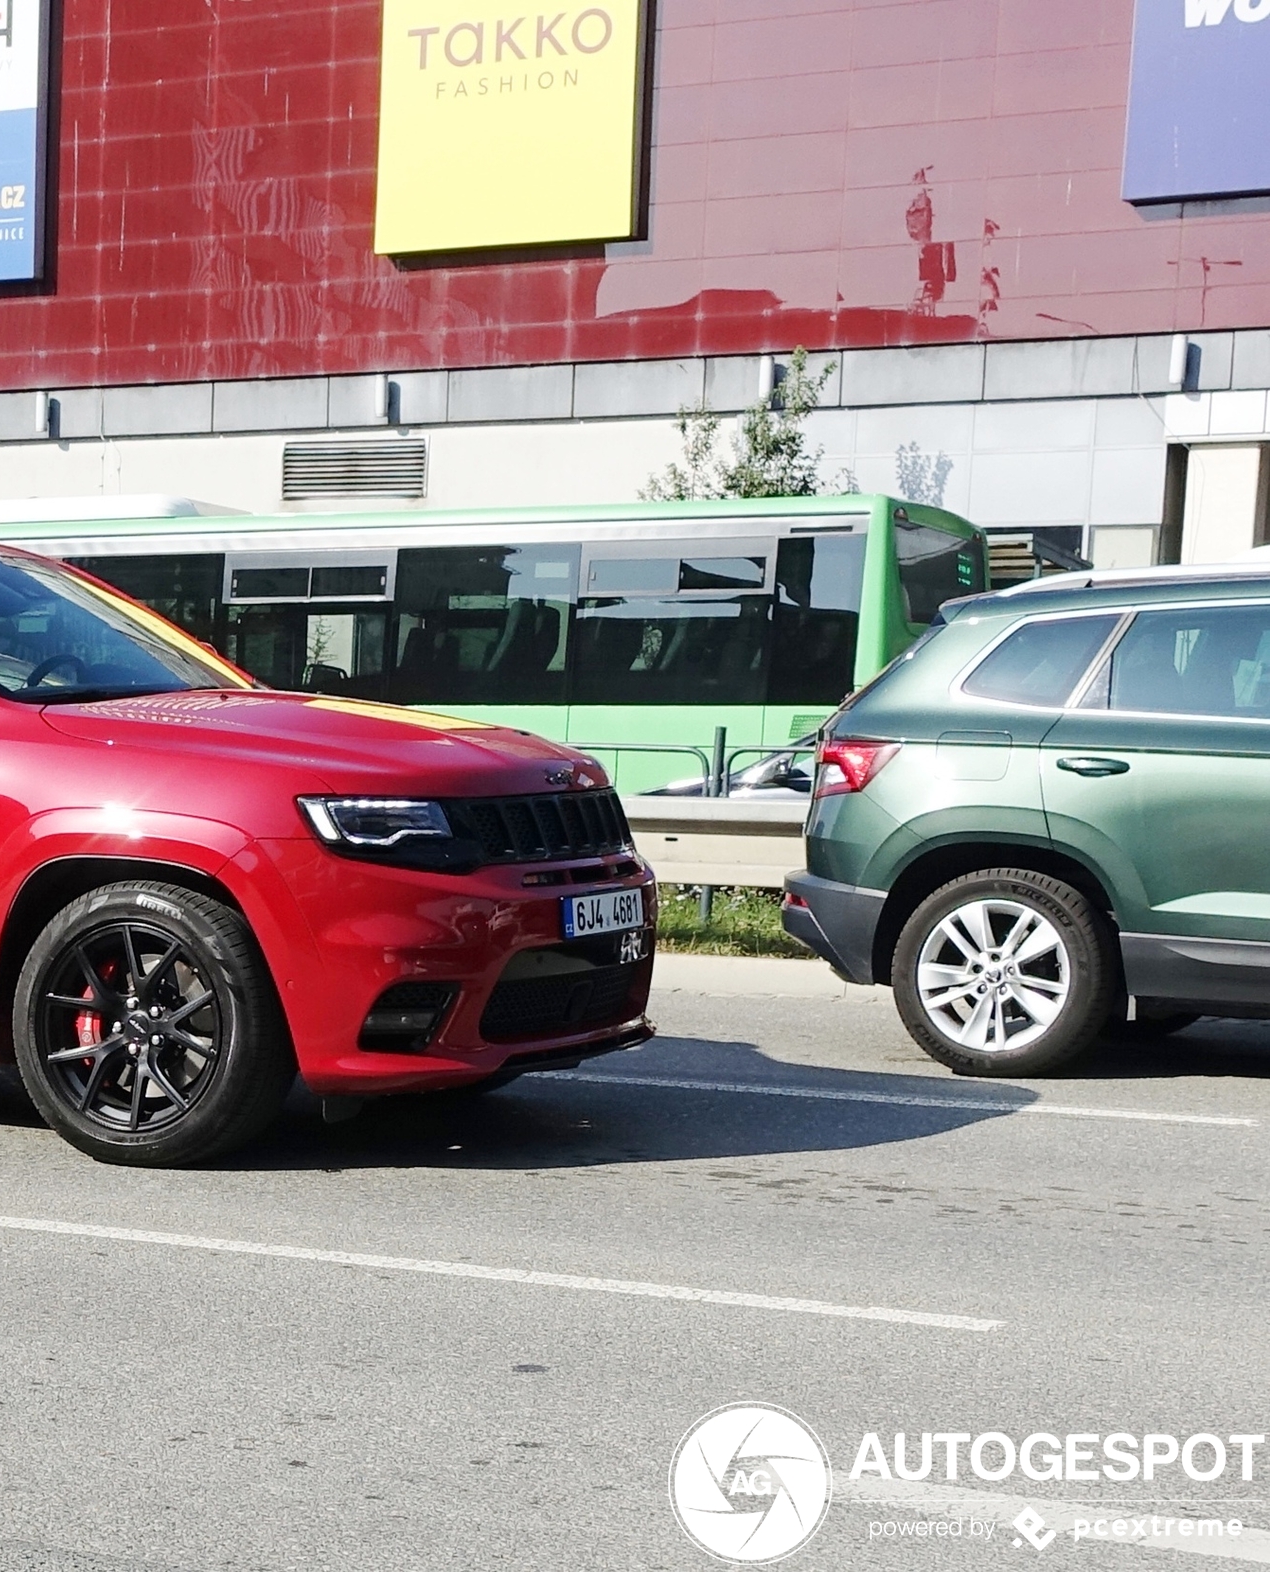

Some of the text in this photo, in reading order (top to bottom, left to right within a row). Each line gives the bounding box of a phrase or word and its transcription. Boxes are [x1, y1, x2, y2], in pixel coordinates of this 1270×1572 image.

[435, 69, 579, 100] FASHION
[576, 893, 639, 931] 6J4 4681
